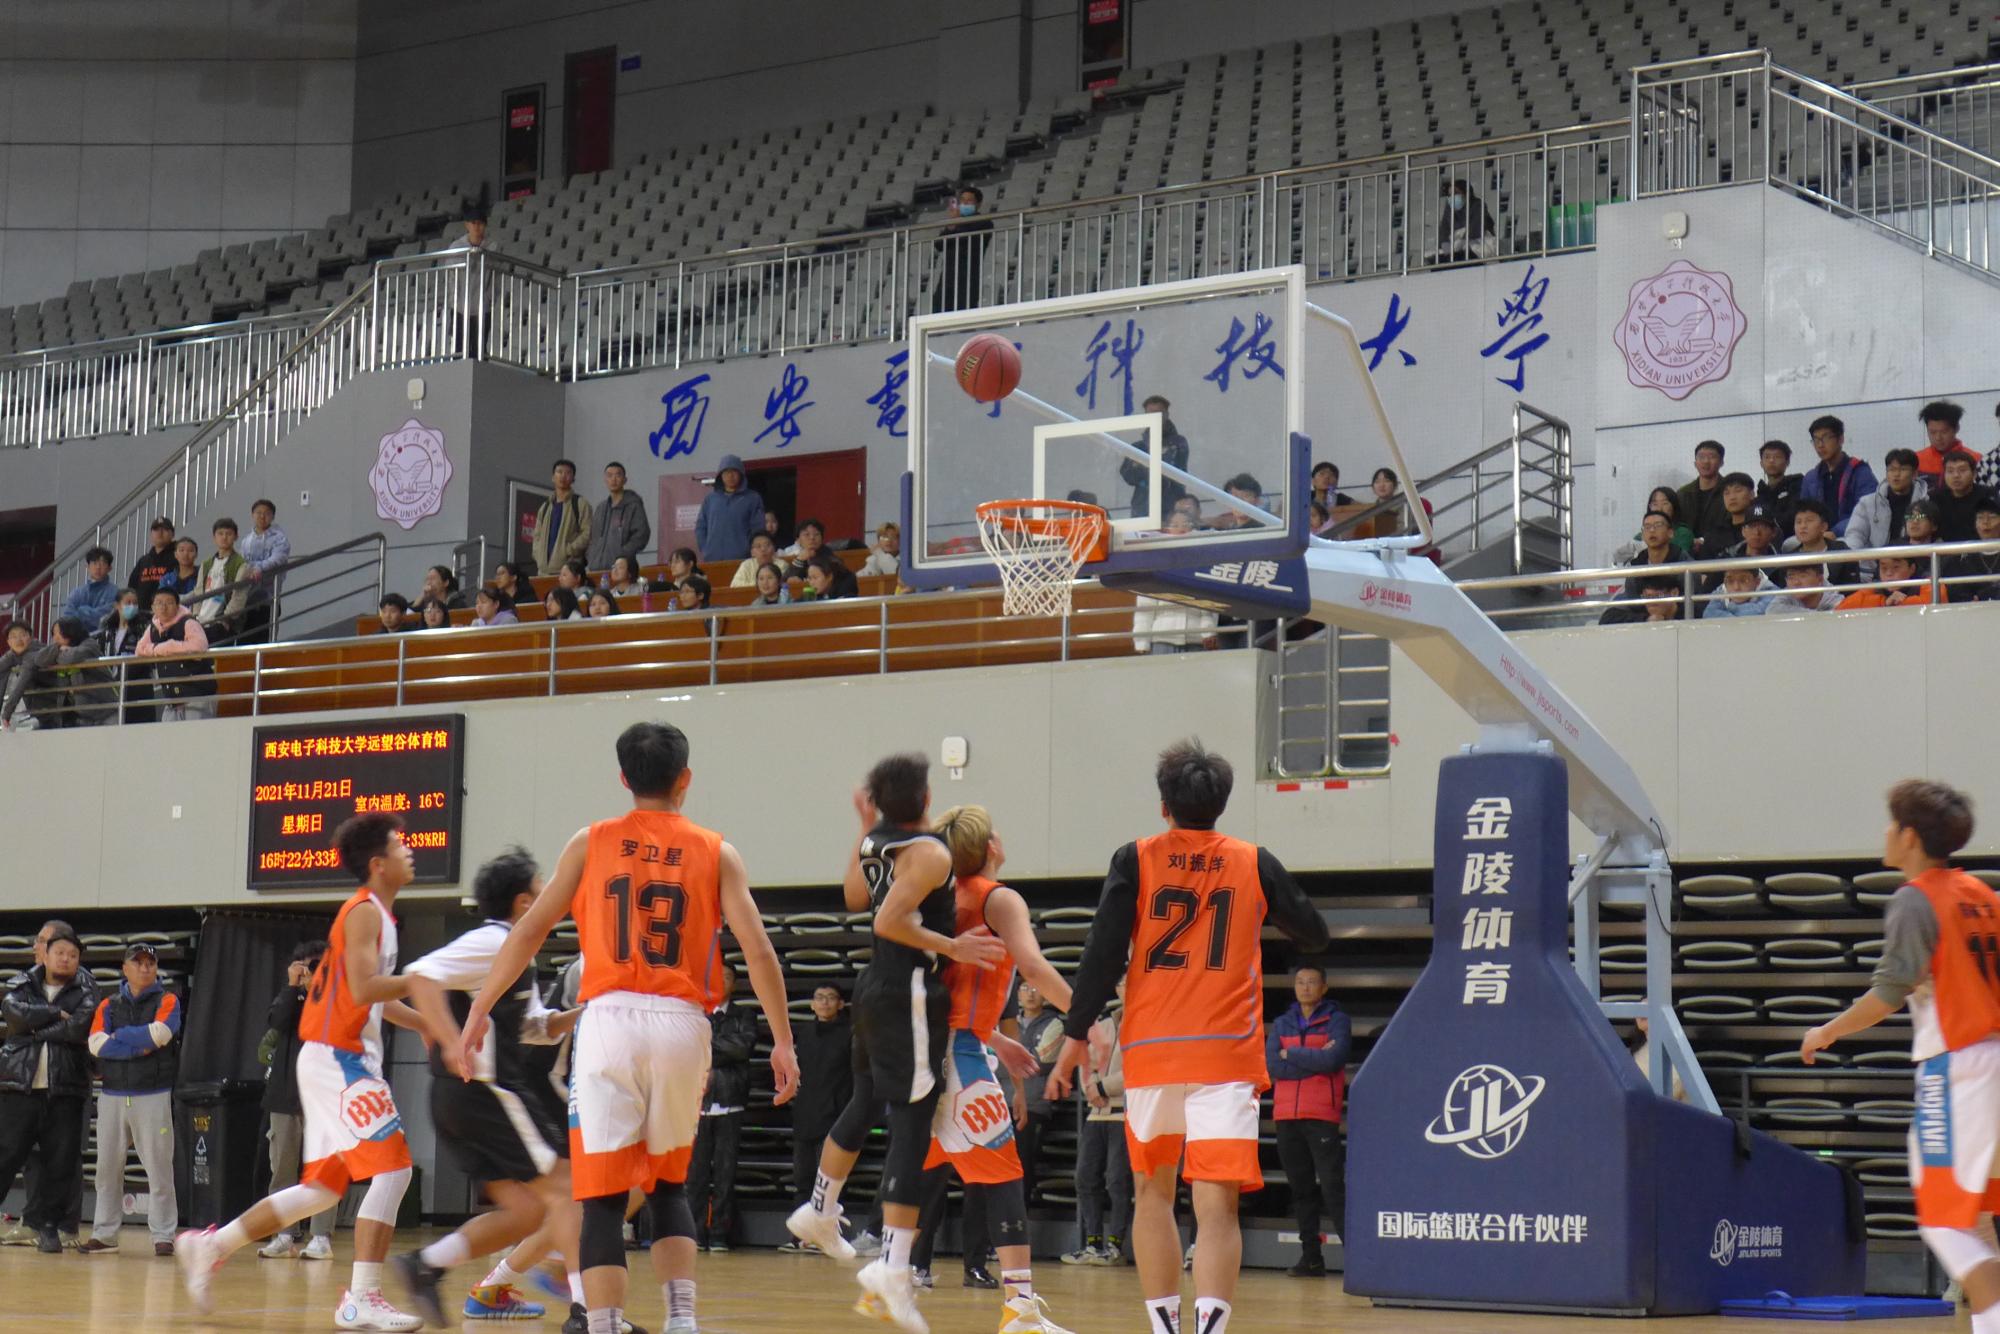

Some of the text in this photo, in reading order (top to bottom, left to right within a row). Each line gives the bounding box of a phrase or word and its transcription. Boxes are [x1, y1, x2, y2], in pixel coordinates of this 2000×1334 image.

[1631, 342, 1726, 385] XIDIAN UNIVERSITY
[400, 484, 440, 518] UNIVERSITY
[264, 730, 449, 759] 西安电子科技大学远望谷体育馆
[255, 778, 352, 802] 2021年11月21日
[281, 813, 323, 835] 星期日
[620, 838, 683, 867] 罗卫星
[1167, 852, 1226, 873] 刘振洋
[1461, 796, 1514, 1006] 金陵体育
[604, 872, 690, 969] 13
[1144, 883, 1237, 973] 21
[1377, 1210, 1589, 1244] 国际篮联合作伙伴
[1737, 1225, 1784, 1248] 金陵体育
